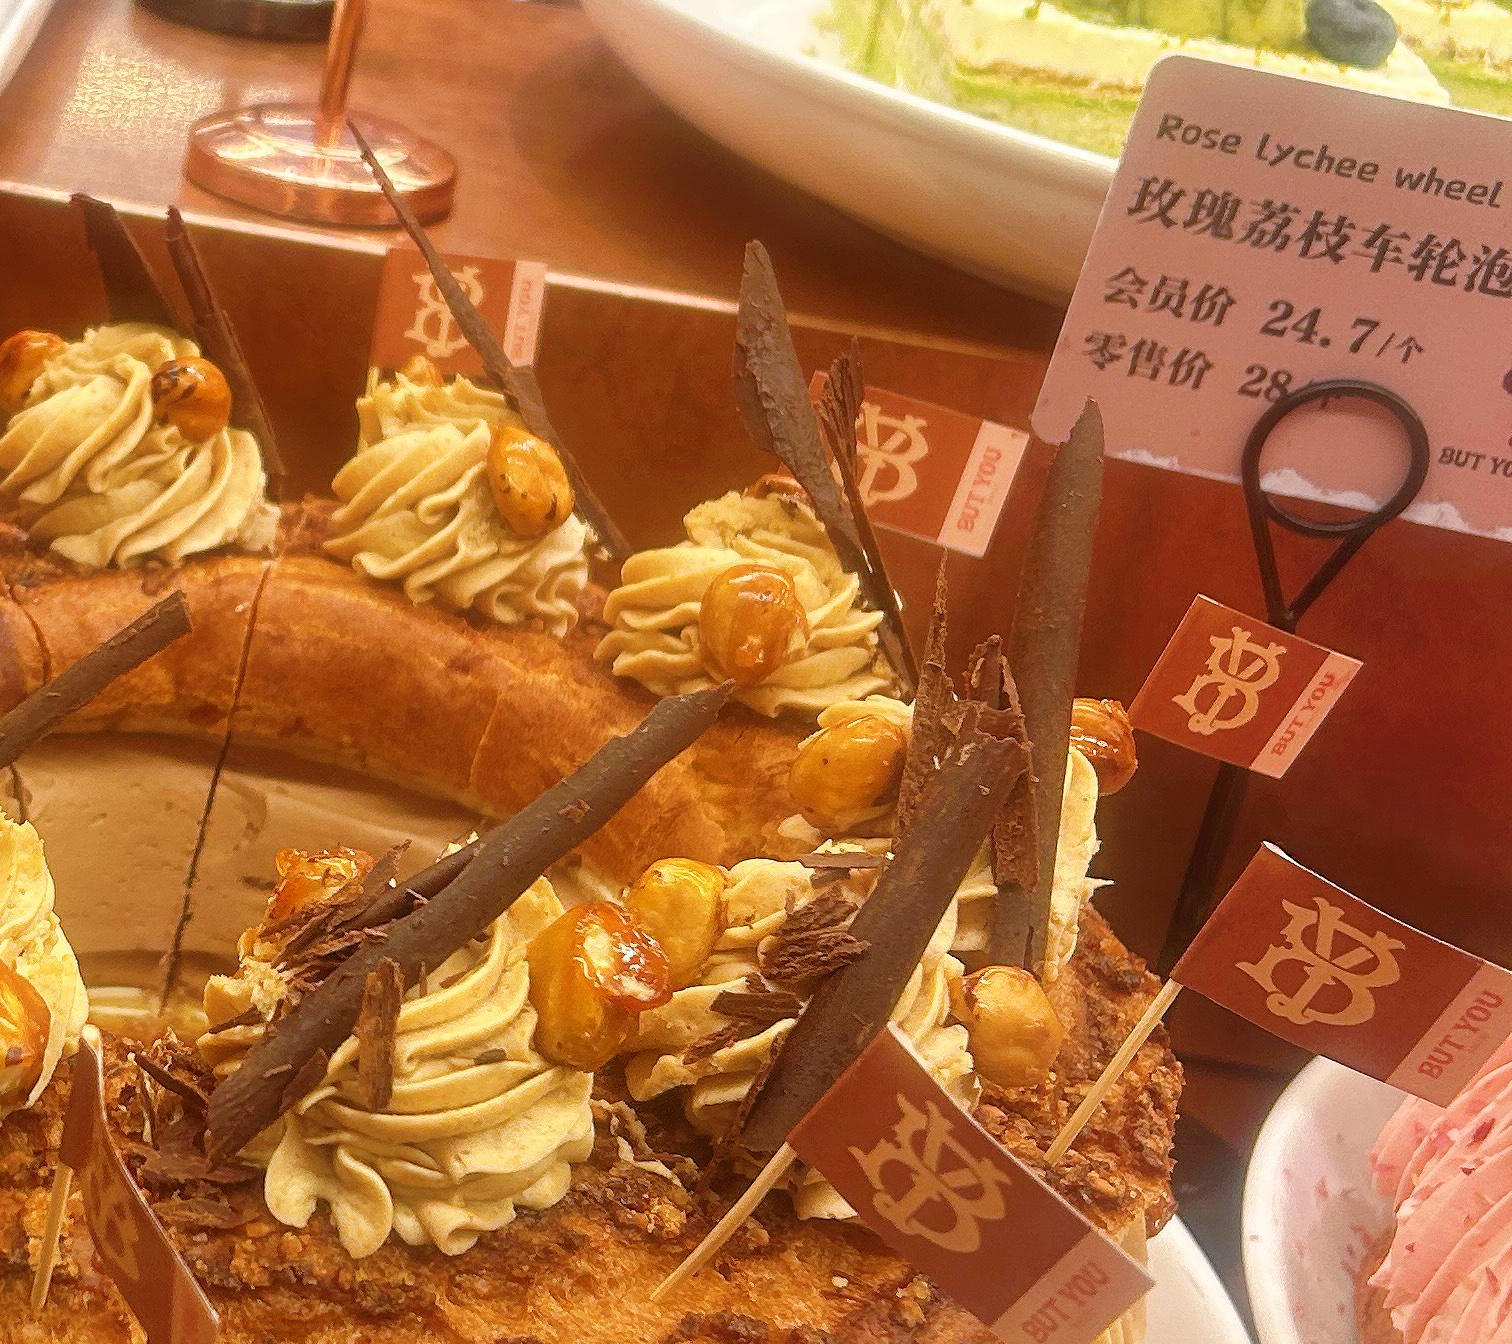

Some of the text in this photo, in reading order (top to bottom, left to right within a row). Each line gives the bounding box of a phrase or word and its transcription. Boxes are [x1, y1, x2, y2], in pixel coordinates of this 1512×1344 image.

[1156, 113, 1242, 154] Rose
[1394, 166, 1504, 209] wheel
[1103, 266, 1236, 327] 会员价
[1084, 330, 1215, 391] 零售价
[956, 446, 1003, 533] BUT YOU
[1438, 446, 1486, 472] BUT
[1271, 672, 1337, 757] BUT YOU
[1417, 989, 1504, 1080] BUT YOU
[1022, 1262, 1110, 1344] BUT YOU
